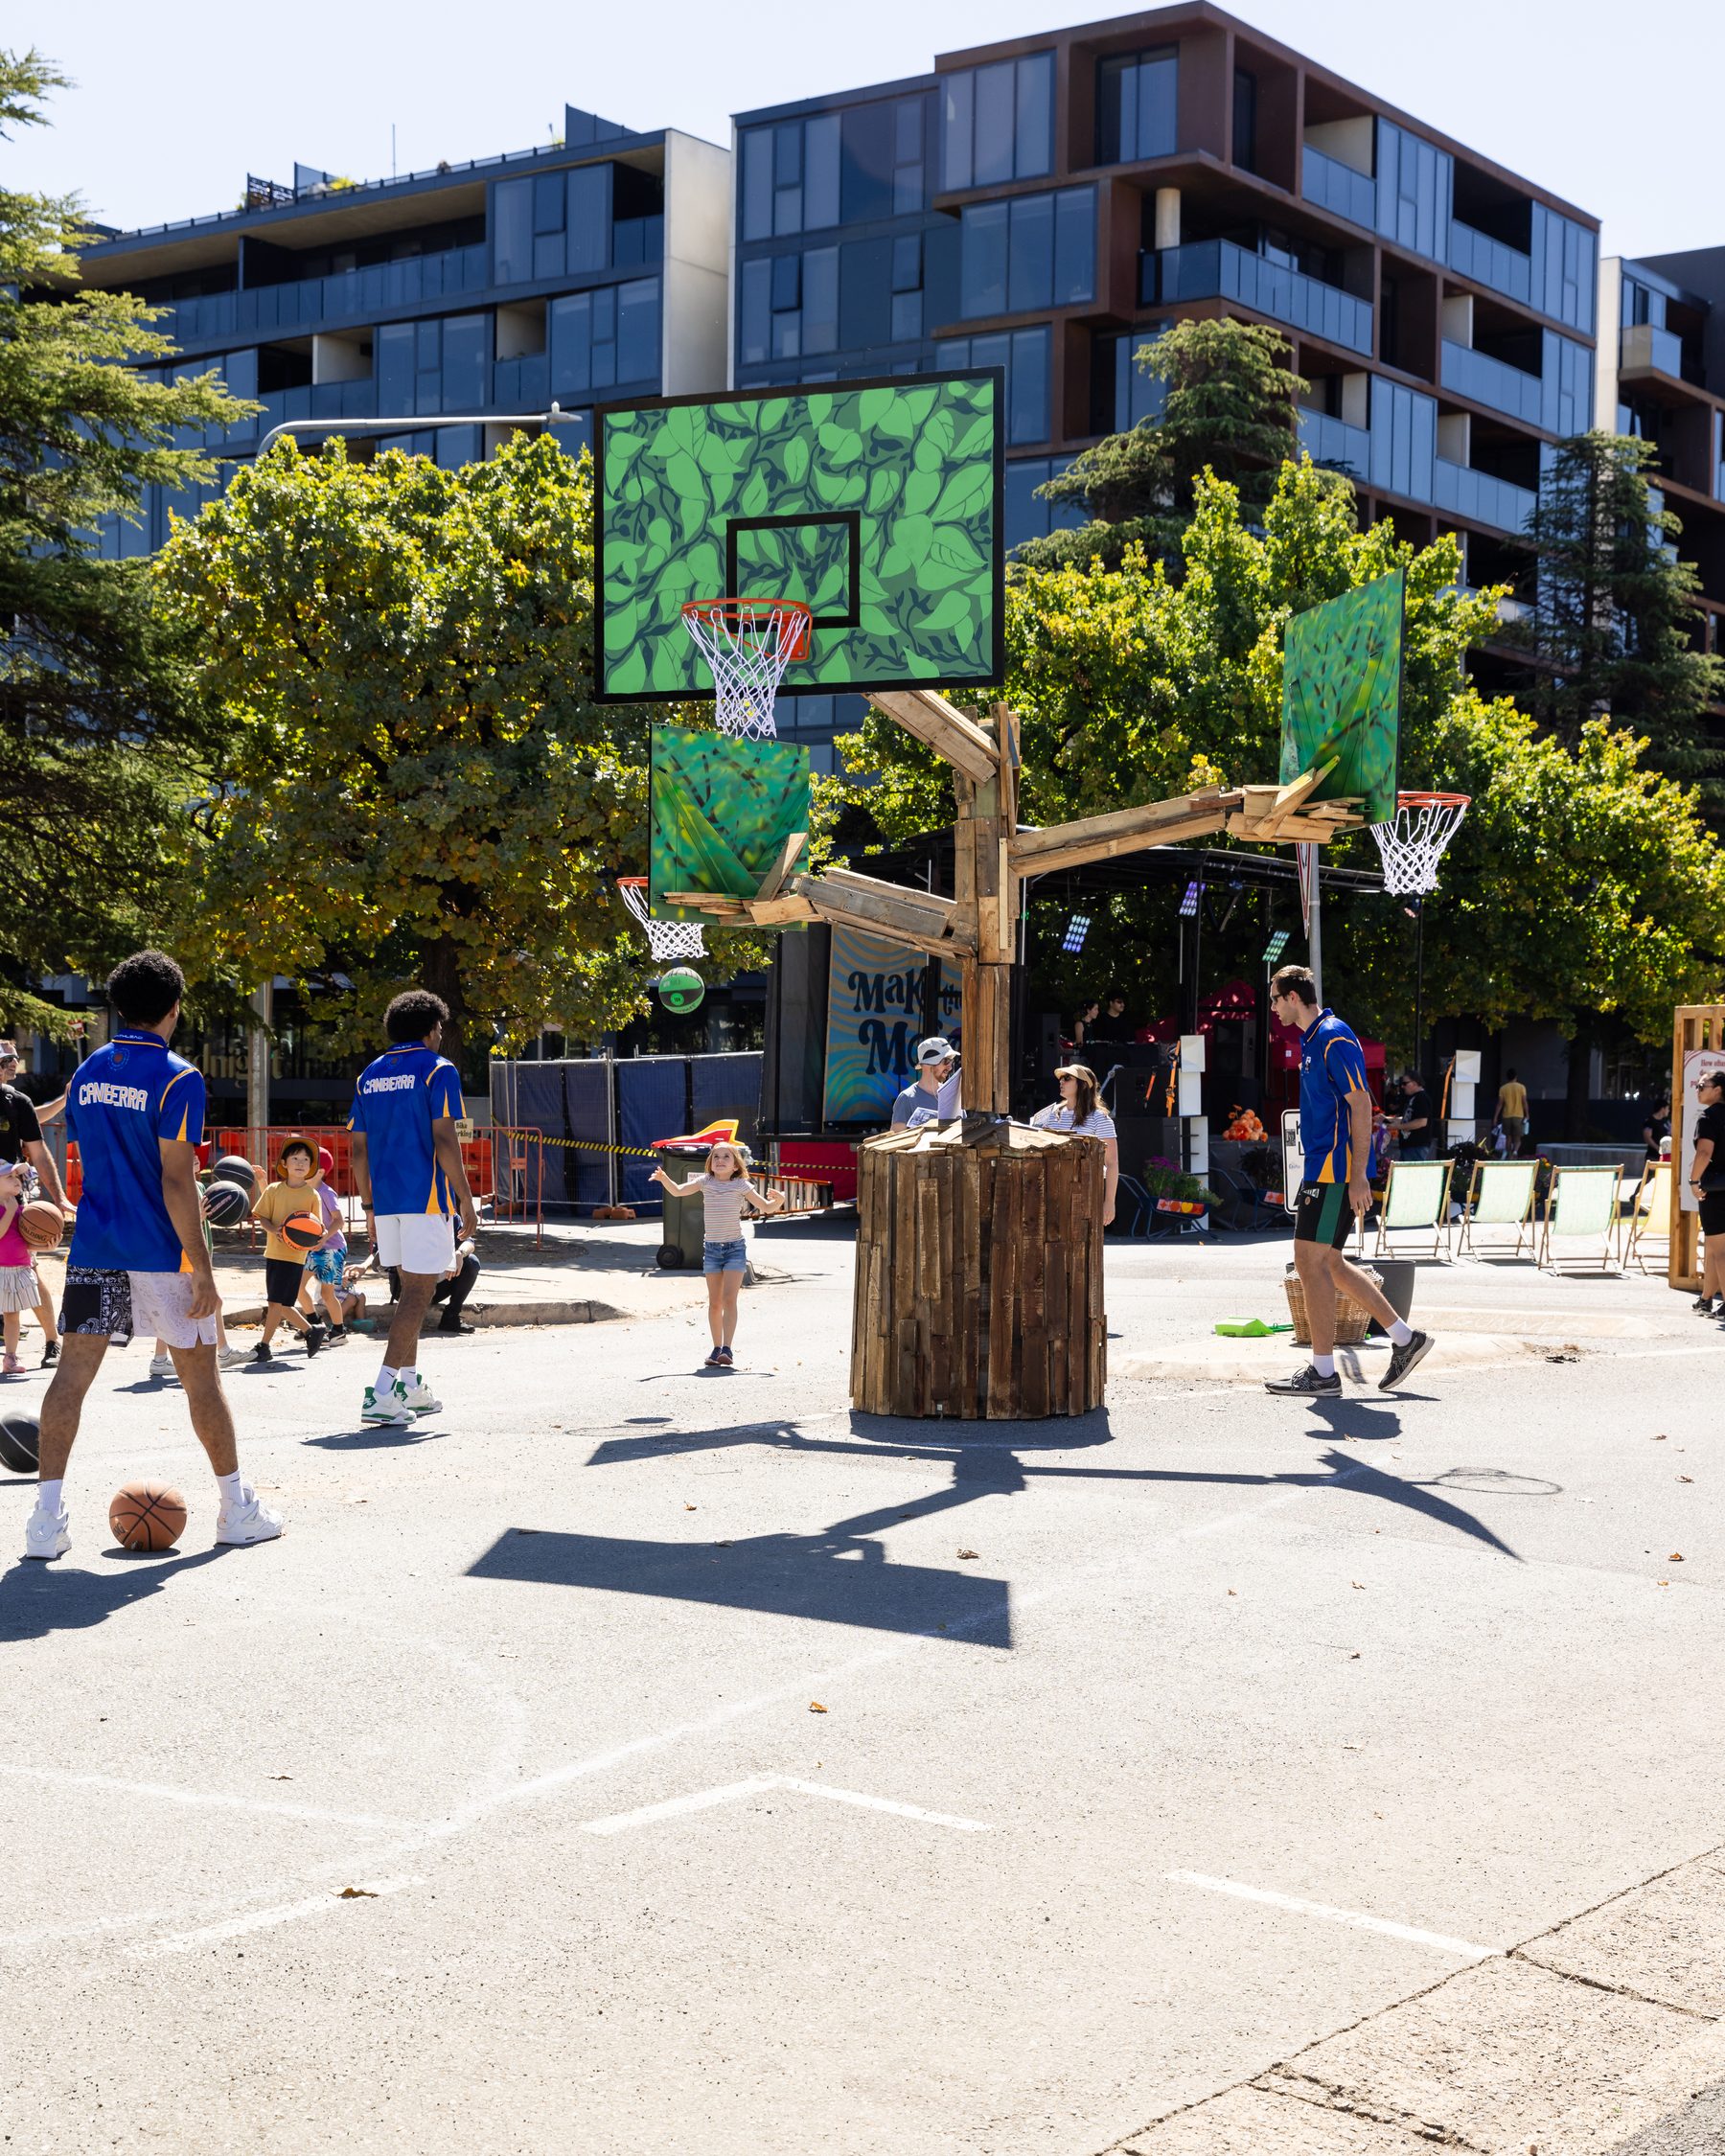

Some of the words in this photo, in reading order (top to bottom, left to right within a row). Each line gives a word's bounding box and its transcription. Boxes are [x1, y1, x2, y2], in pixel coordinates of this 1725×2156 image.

[848, 967, 929, 1014] Mak
[79, 1082, 149, 1112] CANBERRA
[363, 1074, 416, 1094] CANBERRA
